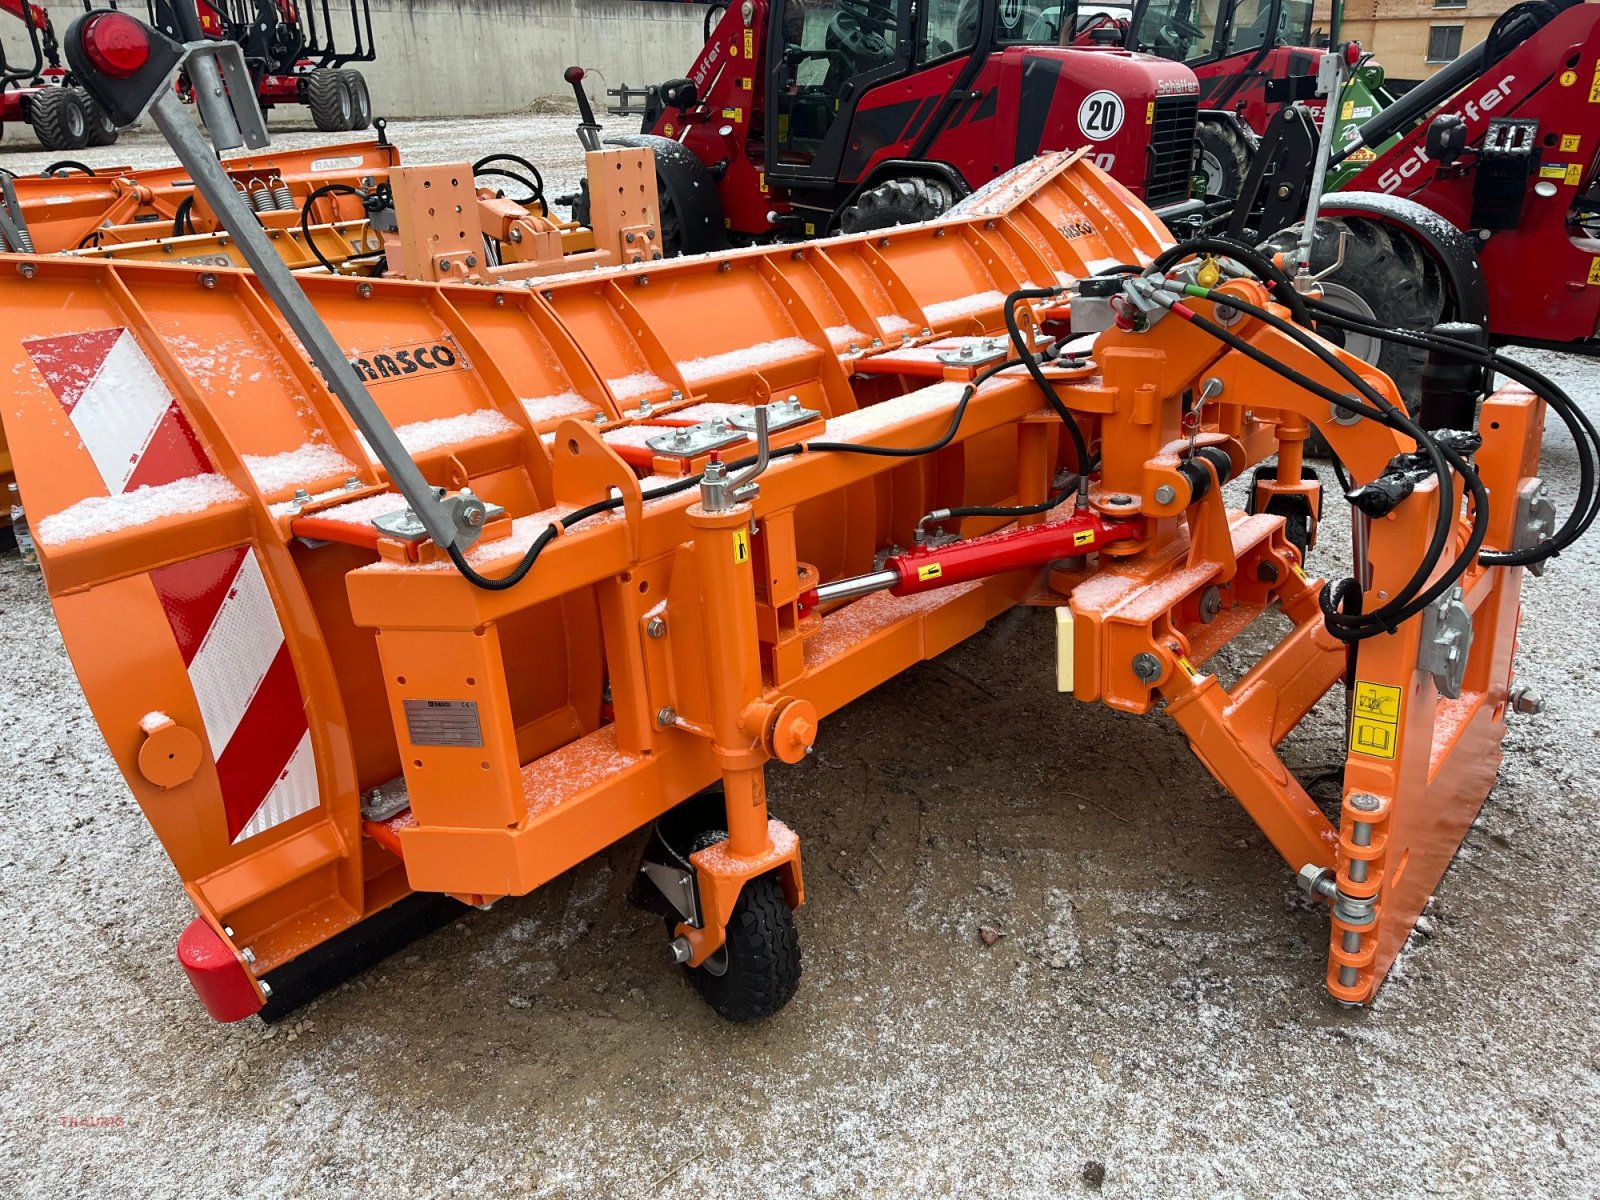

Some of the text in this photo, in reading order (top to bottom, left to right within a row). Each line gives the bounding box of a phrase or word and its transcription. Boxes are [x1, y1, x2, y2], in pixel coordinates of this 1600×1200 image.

[693, 41, 720, 89] äffer
[1157, 79, 1197, 94] Schäffer
[1086, 100, 1116, 132] 20
[350, 344, 456, 382] RASCO
